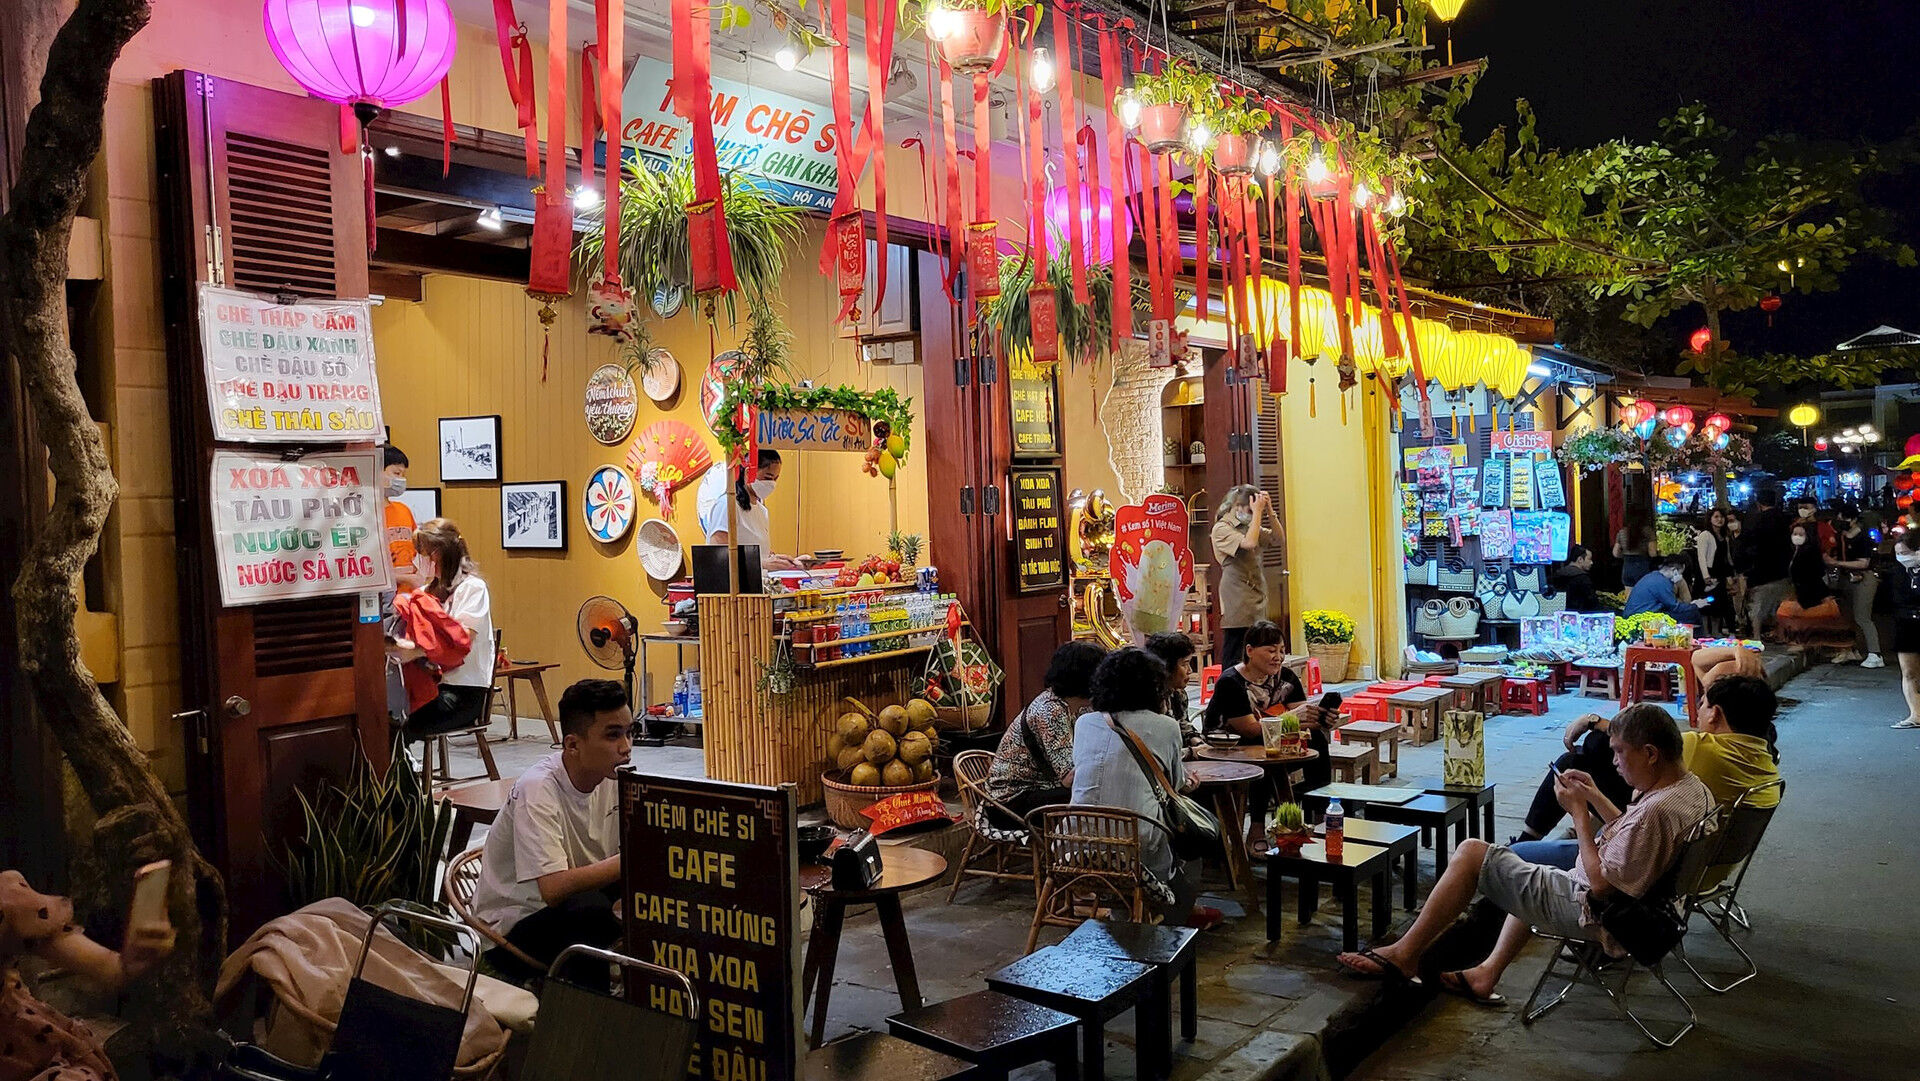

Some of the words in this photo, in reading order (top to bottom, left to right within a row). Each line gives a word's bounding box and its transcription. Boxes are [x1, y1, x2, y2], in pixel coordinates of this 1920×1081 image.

[762, 151, 804, 178] GIẢI
[792, 190, 813, 204] HỘI
[815, 196, 836, 208] AN
[216, 303, 253, 325] CHÈ
[258, 307, 307, 331] THẬP
[219, 328, 258, 349] CHÈ
[262, 330, 301, 353] ĐẬU
[306, 336, 357, 354] XANH
[235, 354, 272, 374] CHÈ
[278, 356, 316, 379] ĐẬU
[322, 355, 347, 377] ĐỎ
[263, 380, 301, 402] ĐẬU
[222, 406, 267, 430] CHÈ
[271, 408, 323, 430] THÁI
[1015, 409, 1034, 422] CAFE
[1018, 433, 1032, 443] CAFE
[1504, 433, 1537, 448] Oishi
[301, 466, 360, 488] XOA
[1020, 478, 1035, 489] XOA
[1036, 478, 1050, 489] XOA
[231, 495, 292, 521] TÀU
[301, 492, 363, 519] PHỚ
[1021, 496, 1035, 509] TÀU
[1147, 500, 1177, 513] Merino
[1018, 516, 1038, 530] BÁNH
[1039, 517, 1057, 528] FLAN
[1127, 521, 1141, 531] Kem
[1142, 518, 1149, 528] số
[1154, 519, 1167, 530] Việt
[1167, 521, 1182, 533] Nam
[233, 525, 322, 553] NƯỚC
[1025, 538, 1042, 549] SINH
[1044, 534, 1053, 548] TỐ
[237, 558, 297, 586] NƯỚC
[302, 552, 331, 581] SẢ
[334, 549, 374, 578] TẮC
[644, 798, 686, 834] TIỆM
[693, 806, 730, 837] CHÈ
[737, 814, 755, 841] SI
[668, 845, 736, 889] CAFE
[634, 892, 689, 929] CAFE
[697, 904, 776, 946] TRỨNG
[651, 940, 700, 979] XOA
[708, 952, 760, 993] XOA
[708, 998, 764, 1044] SEN
